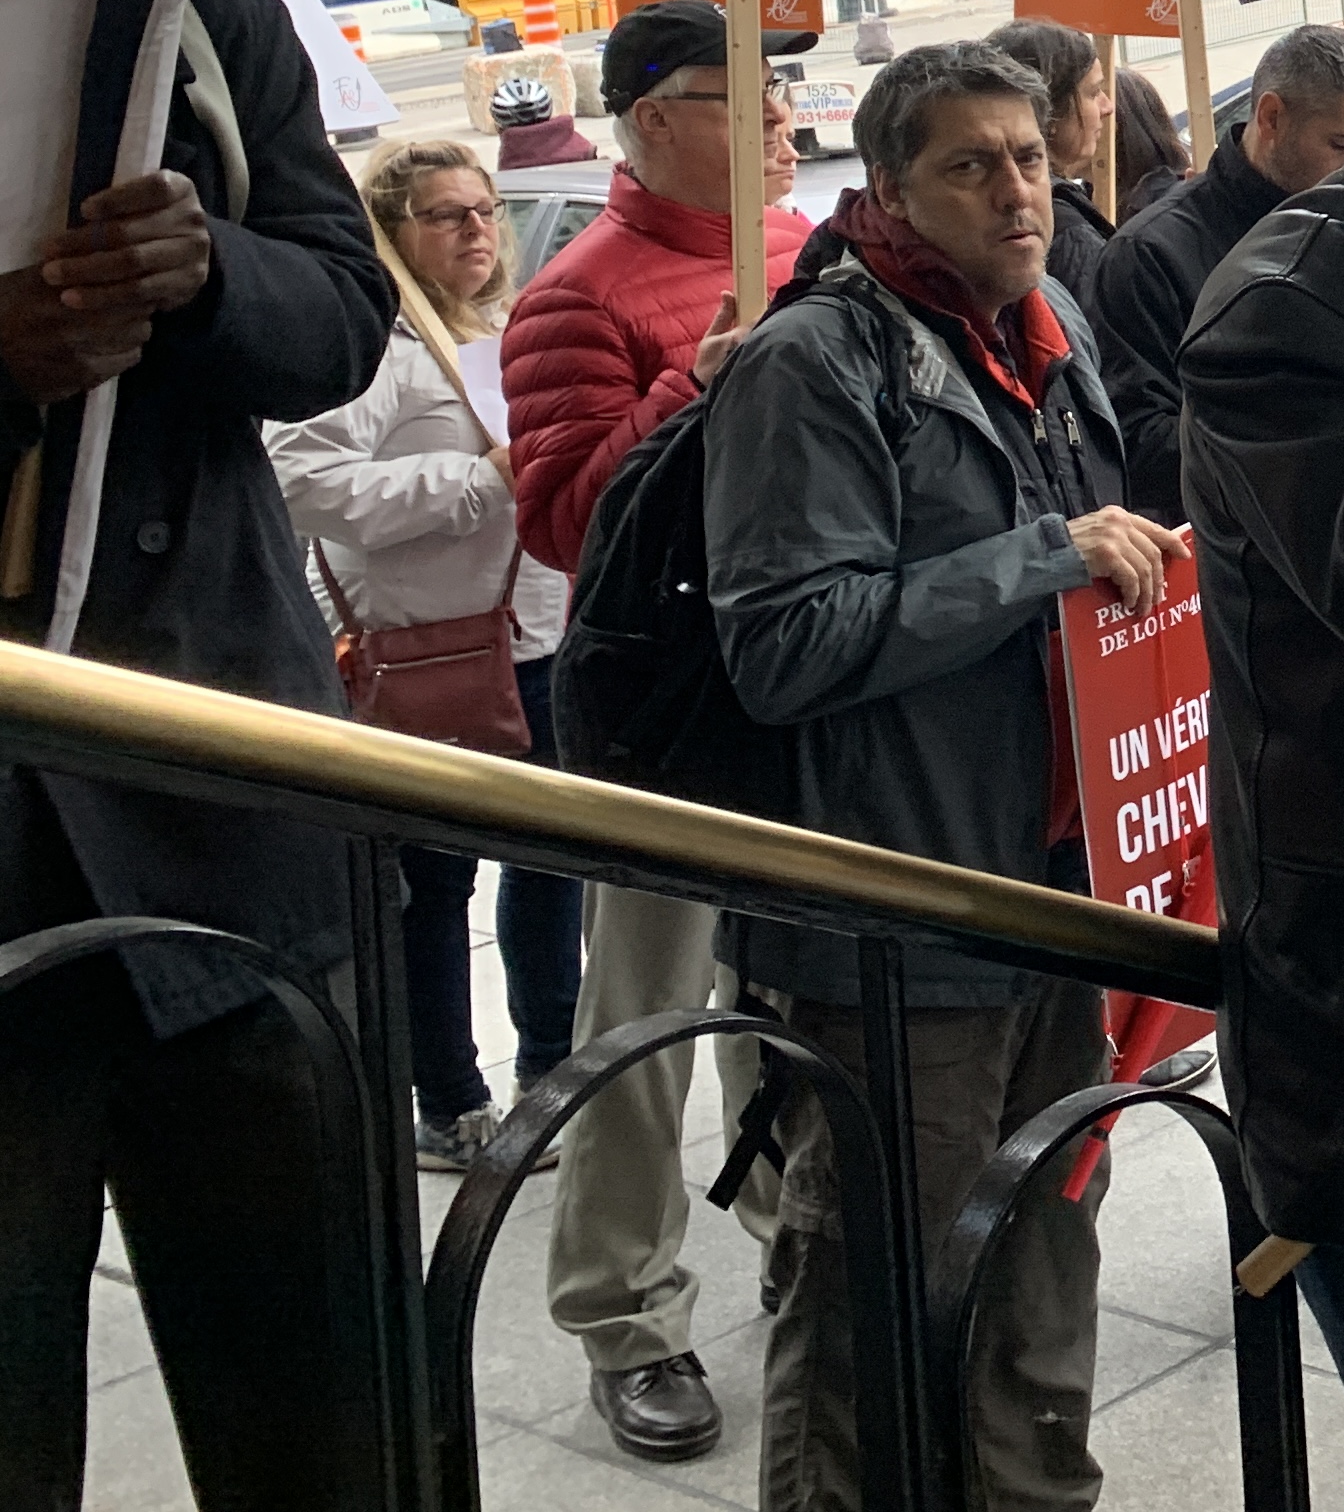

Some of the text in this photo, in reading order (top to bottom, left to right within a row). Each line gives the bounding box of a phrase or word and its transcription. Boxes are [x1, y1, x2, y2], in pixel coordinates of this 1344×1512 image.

[807, 84, 837, 97] 1525
[812, 97, 831, 109] VIP
[1098, 630, 1129, 657] DE
[1133, 610, 1167, 650] LOI
[1109, 689, 1211, 781] UN VÉRI
